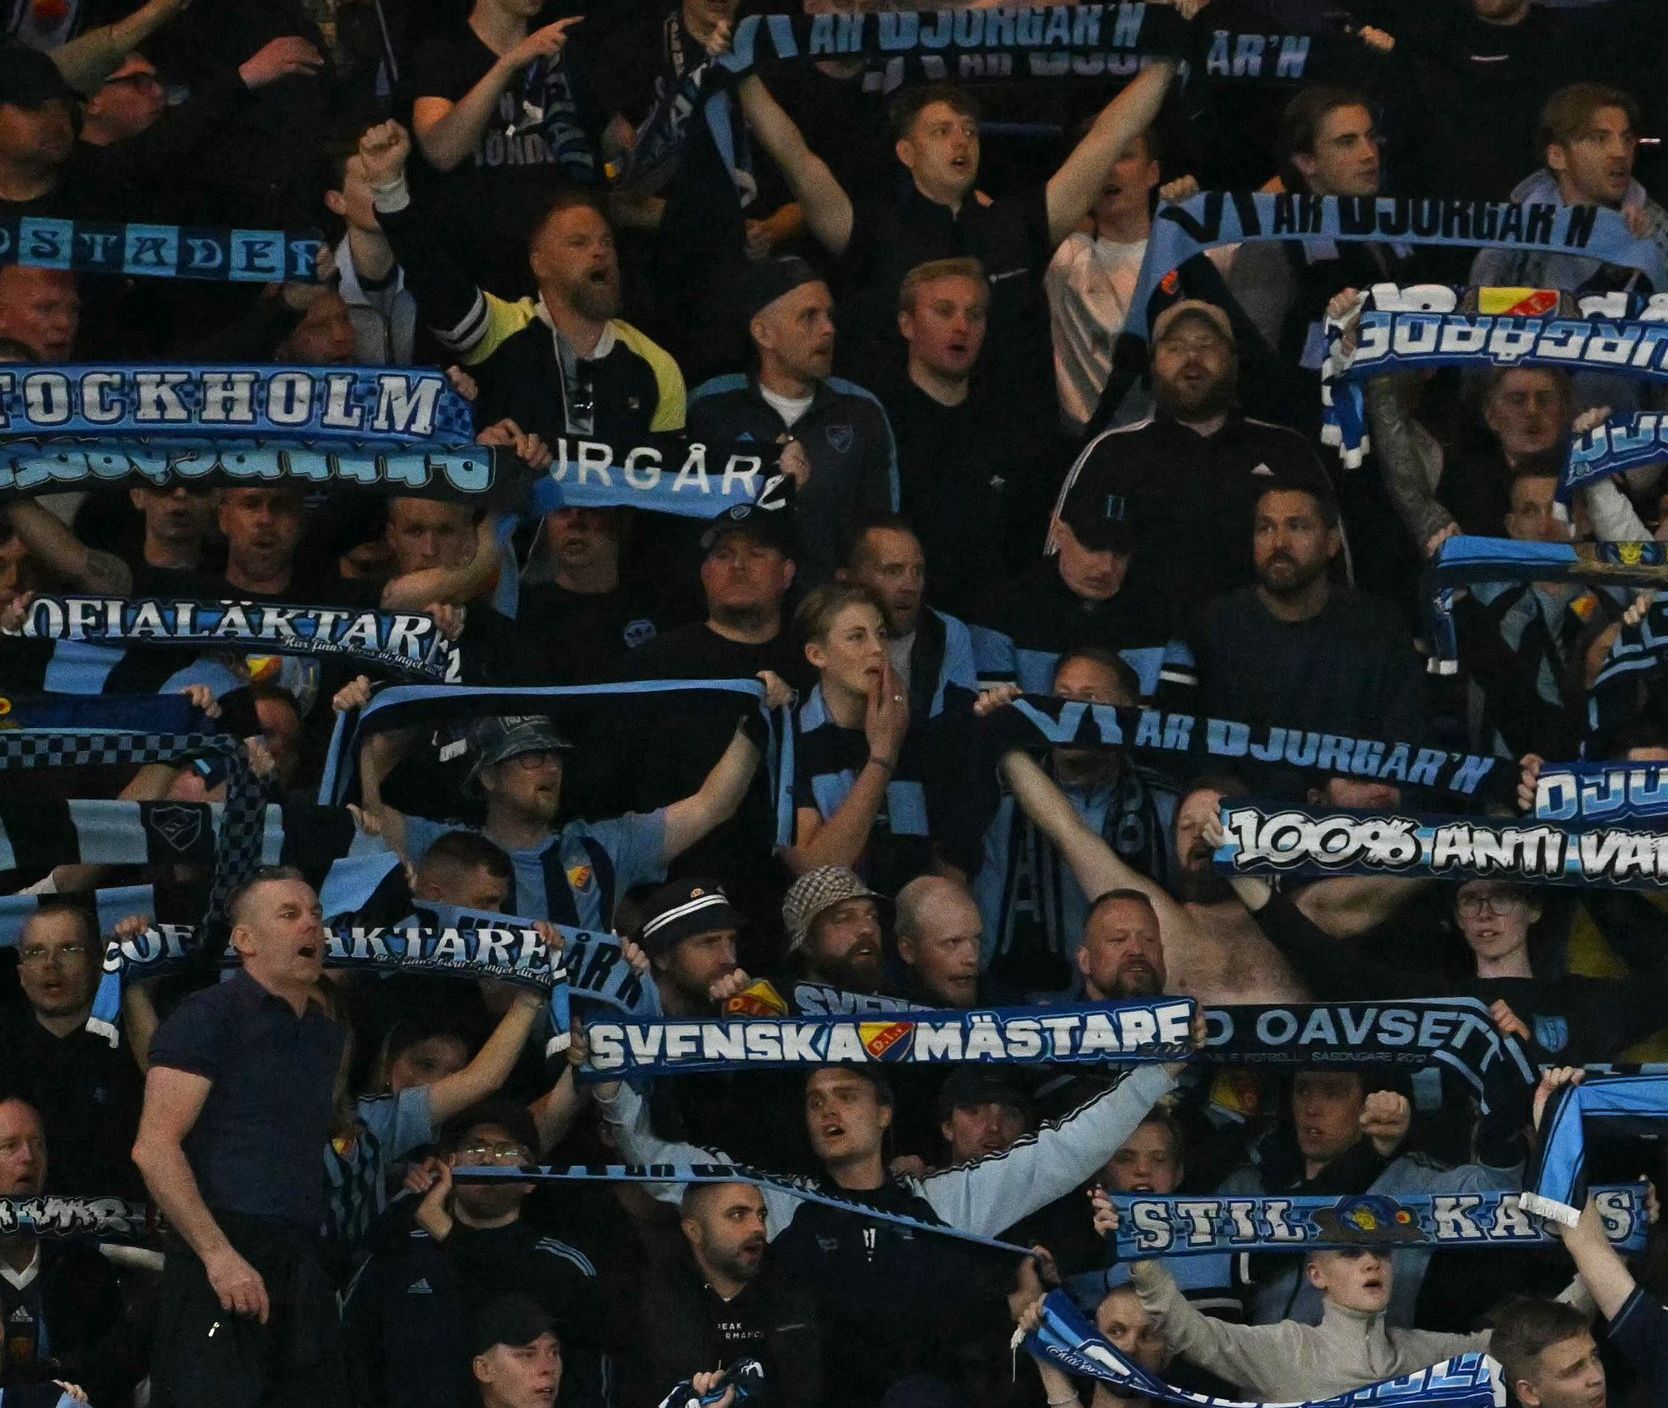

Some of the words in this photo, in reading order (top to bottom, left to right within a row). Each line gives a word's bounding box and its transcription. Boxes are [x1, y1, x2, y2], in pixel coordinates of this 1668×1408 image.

[1229, 807, 1420, 870] 100%
[590, 1015, 855, 1072] SVENSKA
[1130, 1198, 1308, 1252] STIL
